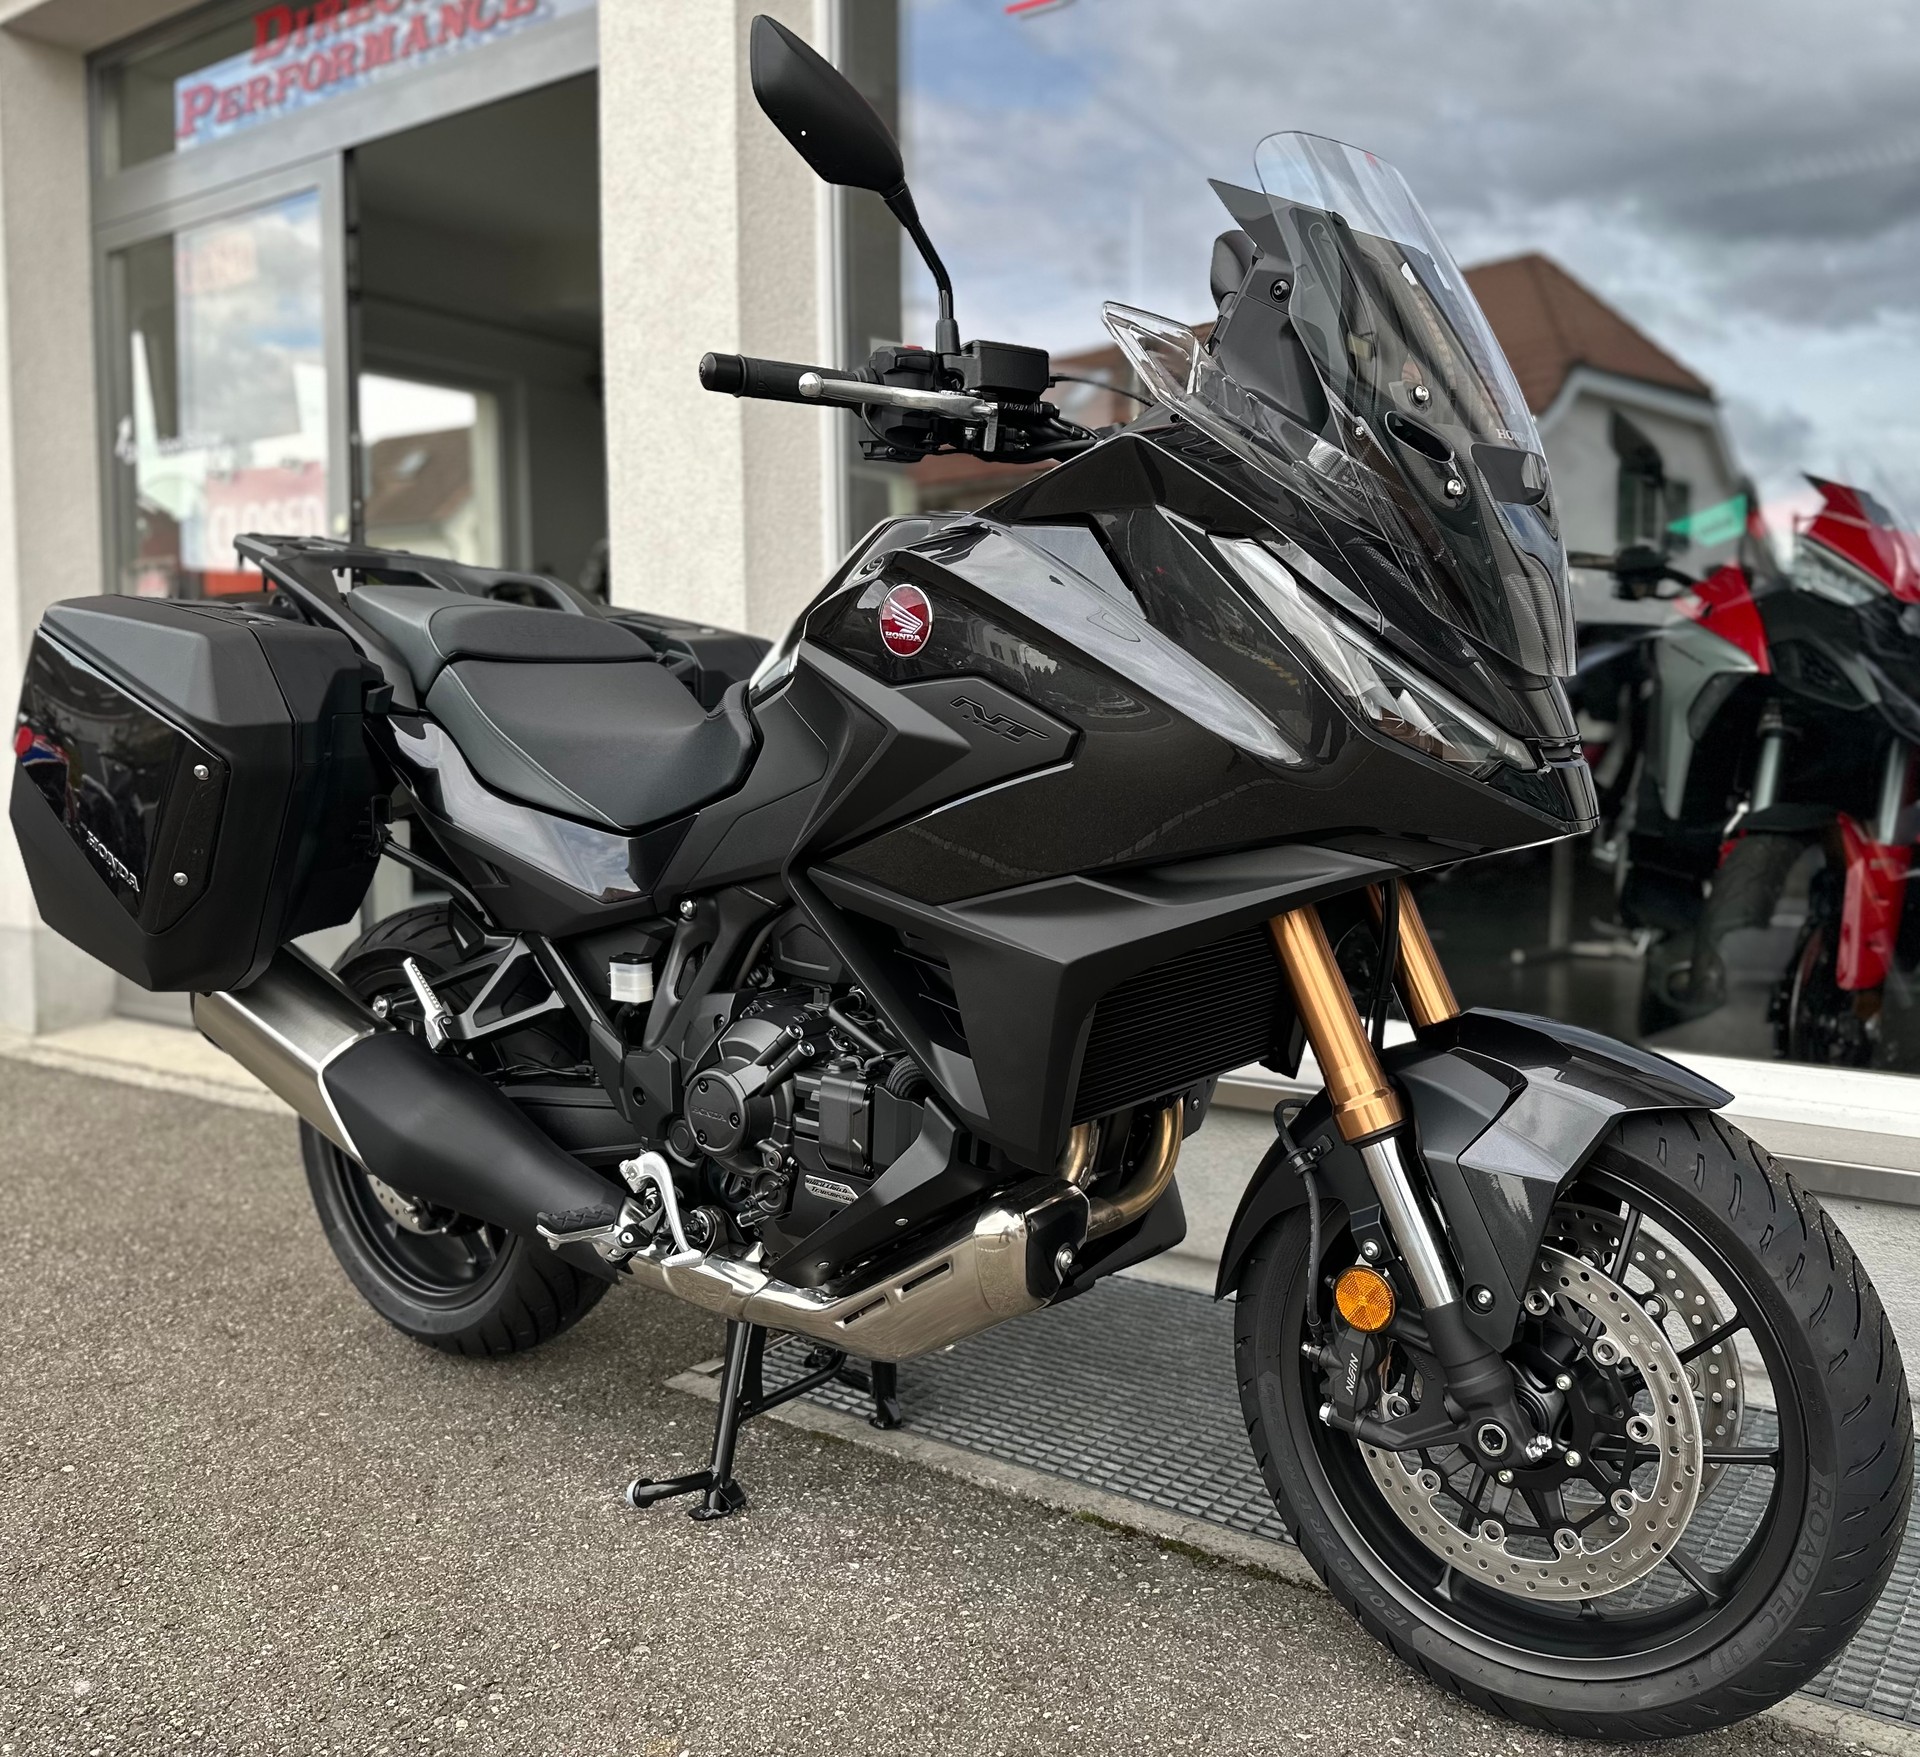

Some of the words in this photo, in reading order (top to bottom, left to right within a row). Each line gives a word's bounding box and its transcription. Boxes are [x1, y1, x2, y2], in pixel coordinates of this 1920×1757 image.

[1496, 428, 1528, 443] HOND
[885, 631, 923, 643] HONDA
[86, 829, 140, 892] HONDA
[691, 1105, 727, 1122] HONDA
[1336, 1556, 1408, 1628] 120/70
